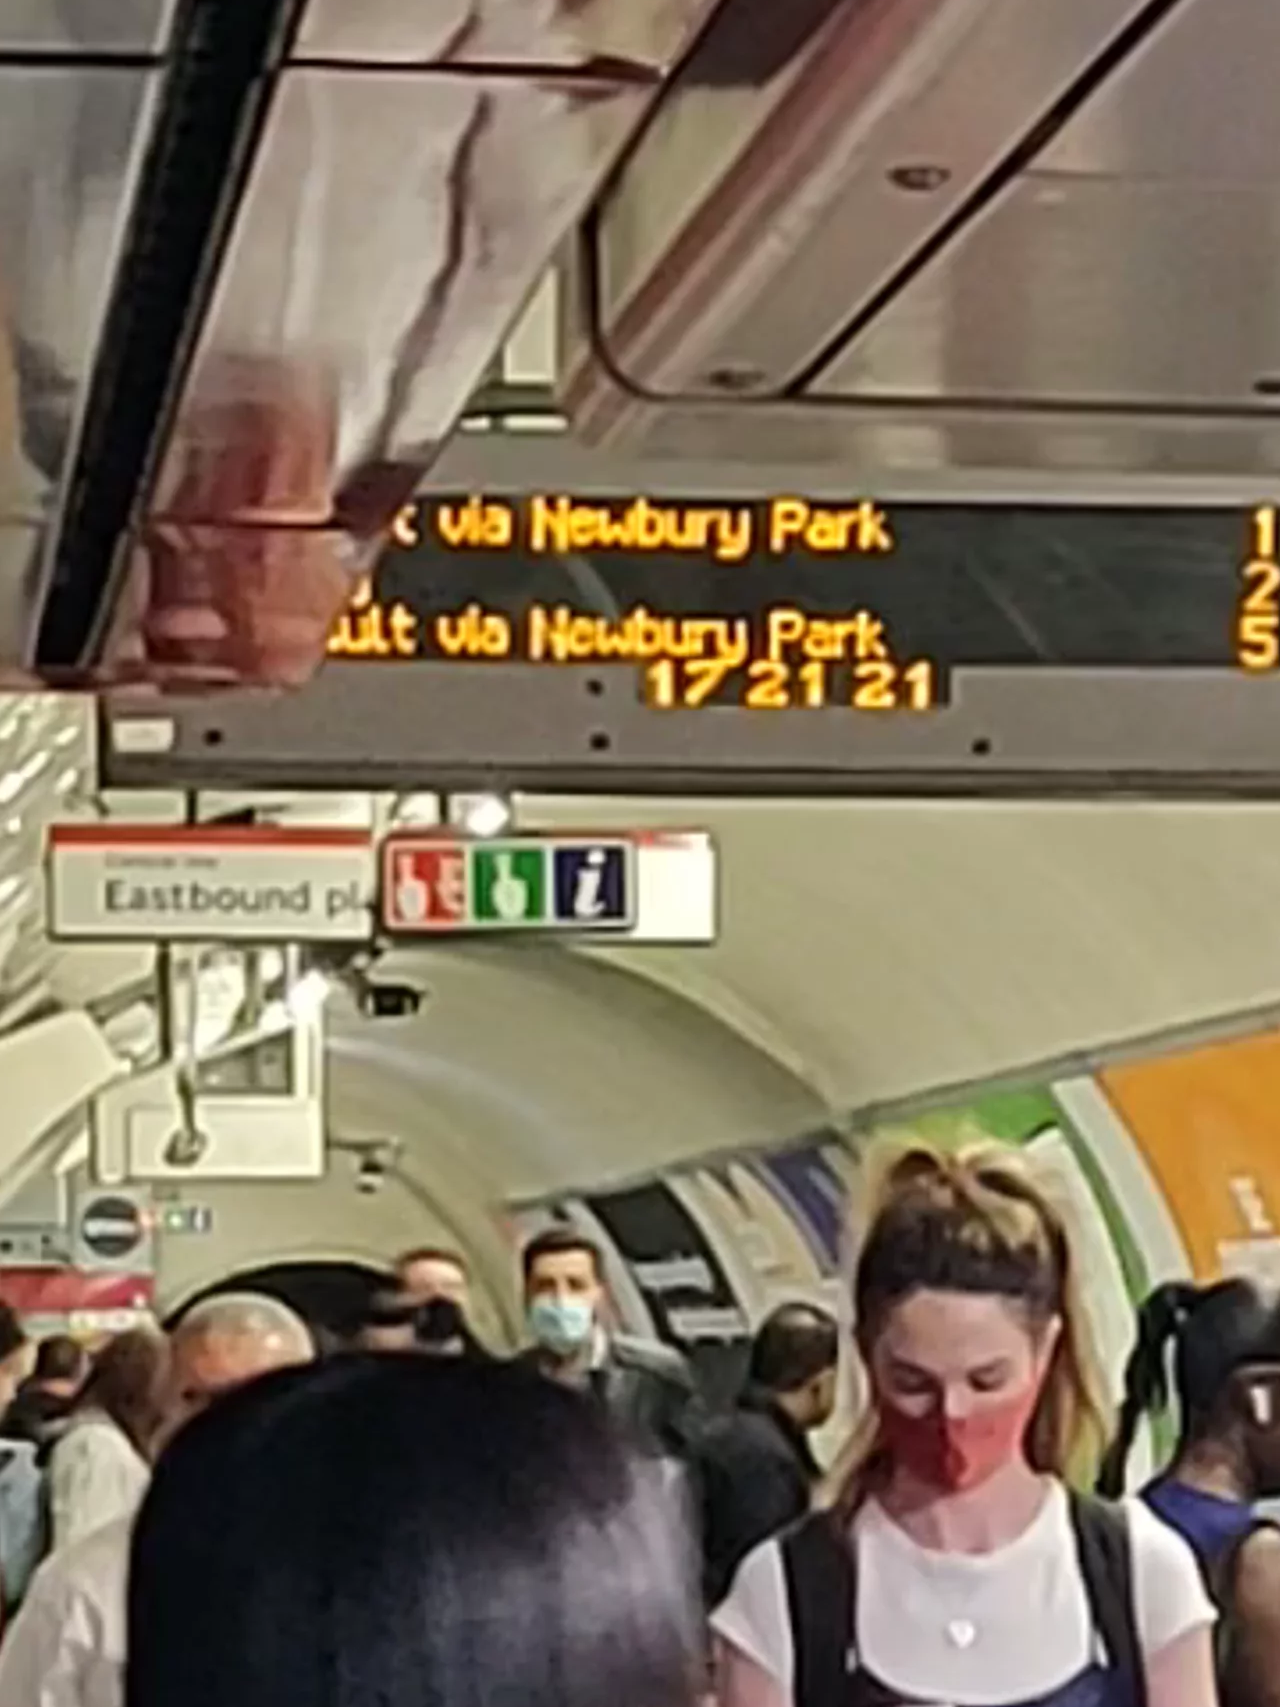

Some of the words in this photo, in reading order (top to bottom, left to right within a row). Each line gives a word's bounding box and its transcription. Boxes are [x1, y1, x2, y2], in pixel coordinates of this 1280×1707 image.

[437, 497, 513, 547] via
[530, 498, 751, 560] Newbury
[770, 501, 894, 552] Park
[1255, 505, 1276, 557] 1
[436, 605, 511, 656] via
[528, 604, 748, 666] Newbury
[768, 609, 888, 661] Park
[1238, 615, 1280, 669] 5
[104, 879, 314, 915] Eastbound
